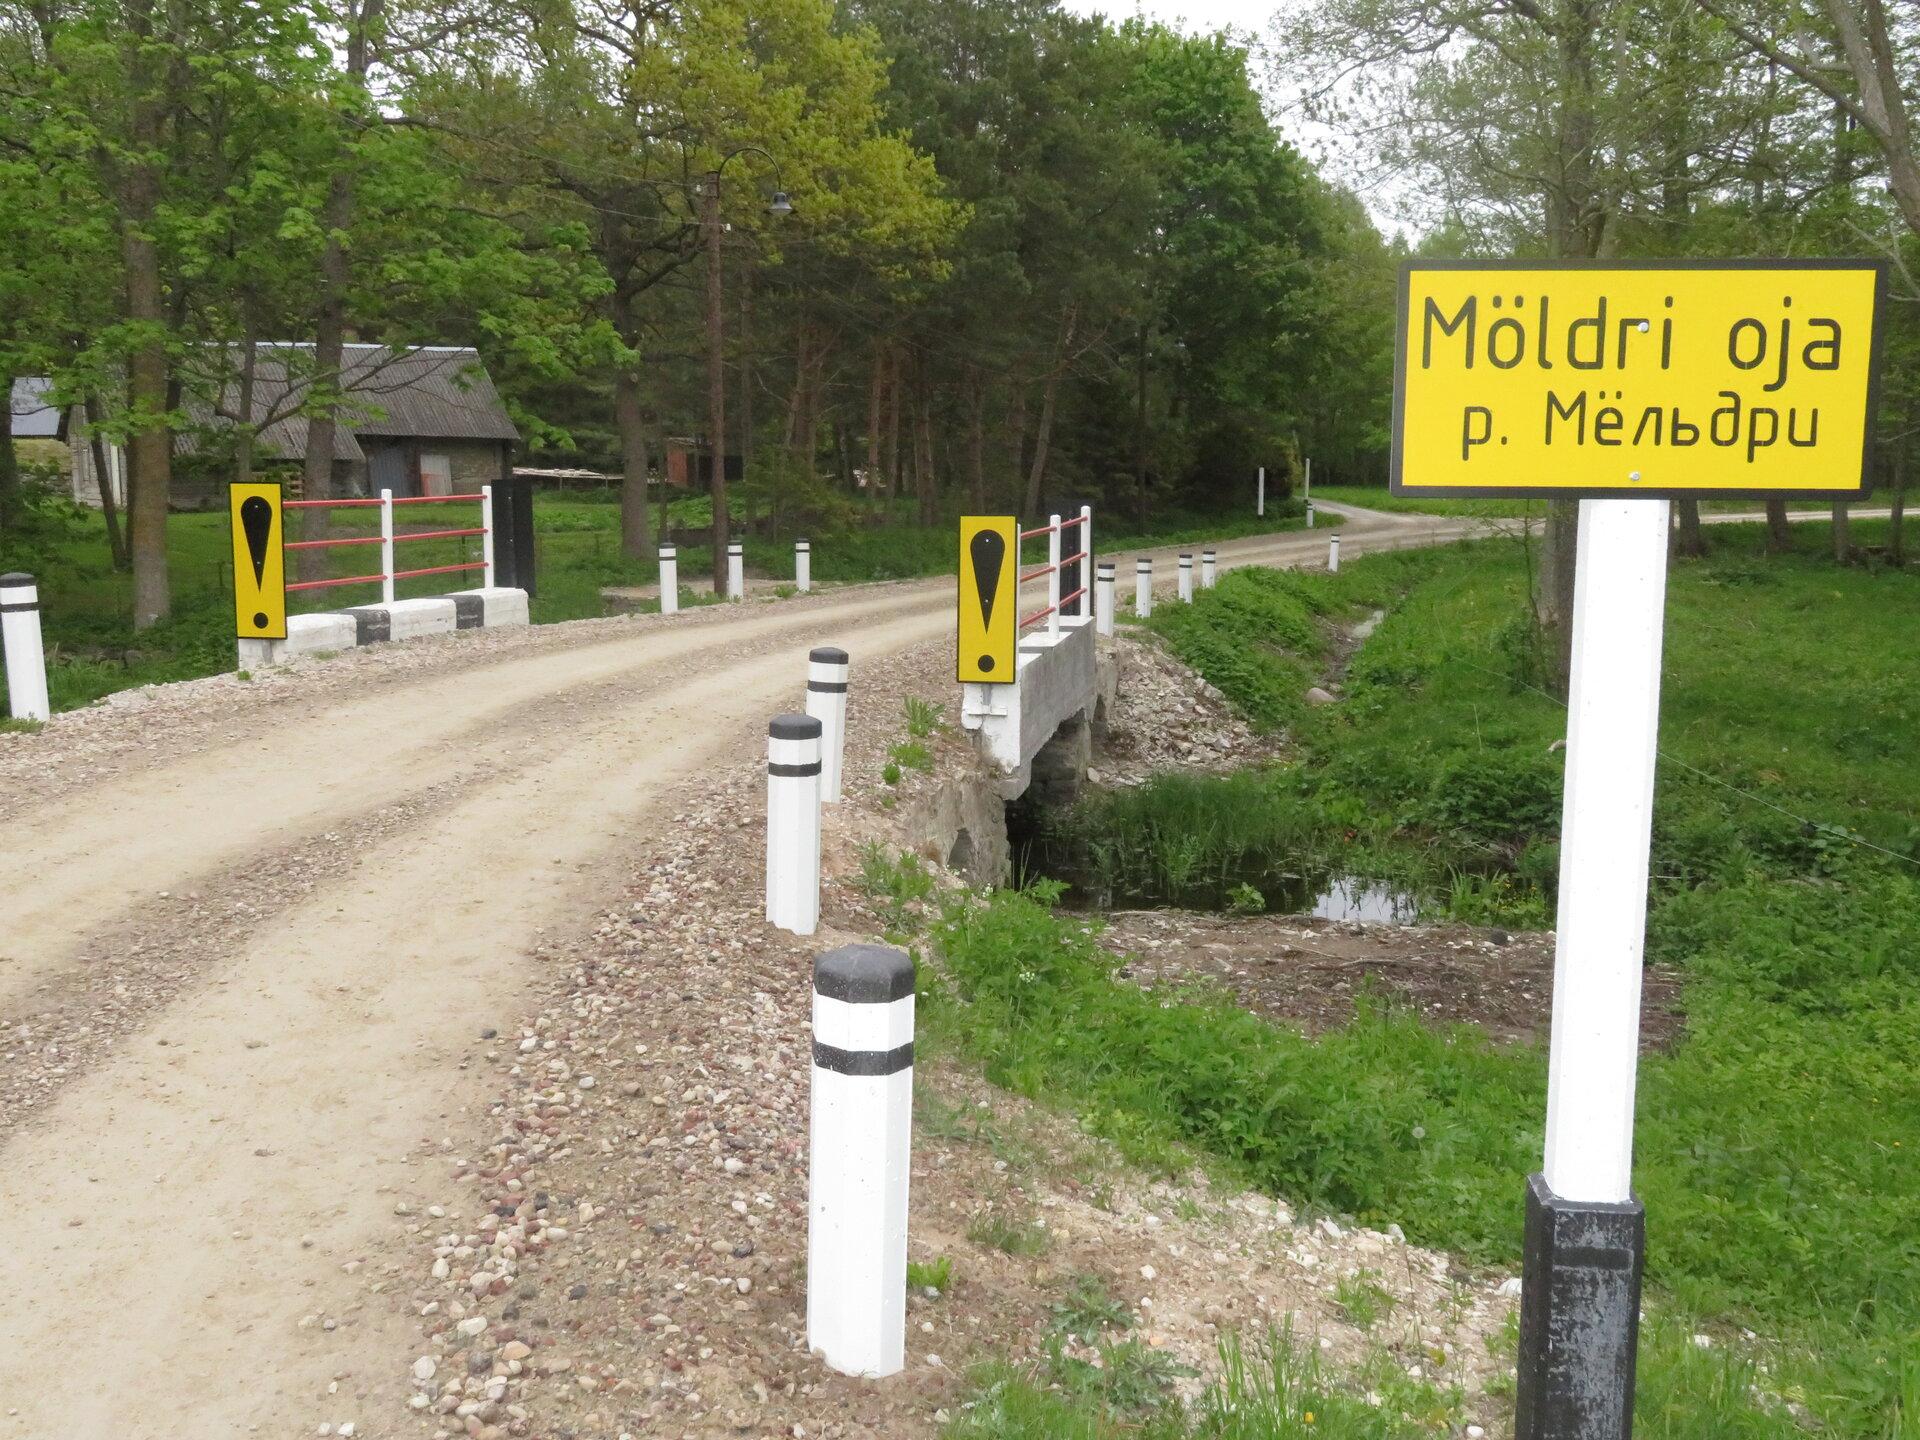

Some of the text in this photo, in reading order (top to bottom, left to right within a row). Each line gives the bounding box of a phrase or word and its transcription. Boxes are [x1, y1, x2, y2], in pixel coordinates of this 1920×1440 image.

[1422, 295, 1843, 393] Möldri oja
[1462, 389, 1820, 464] р. Мёльдри
